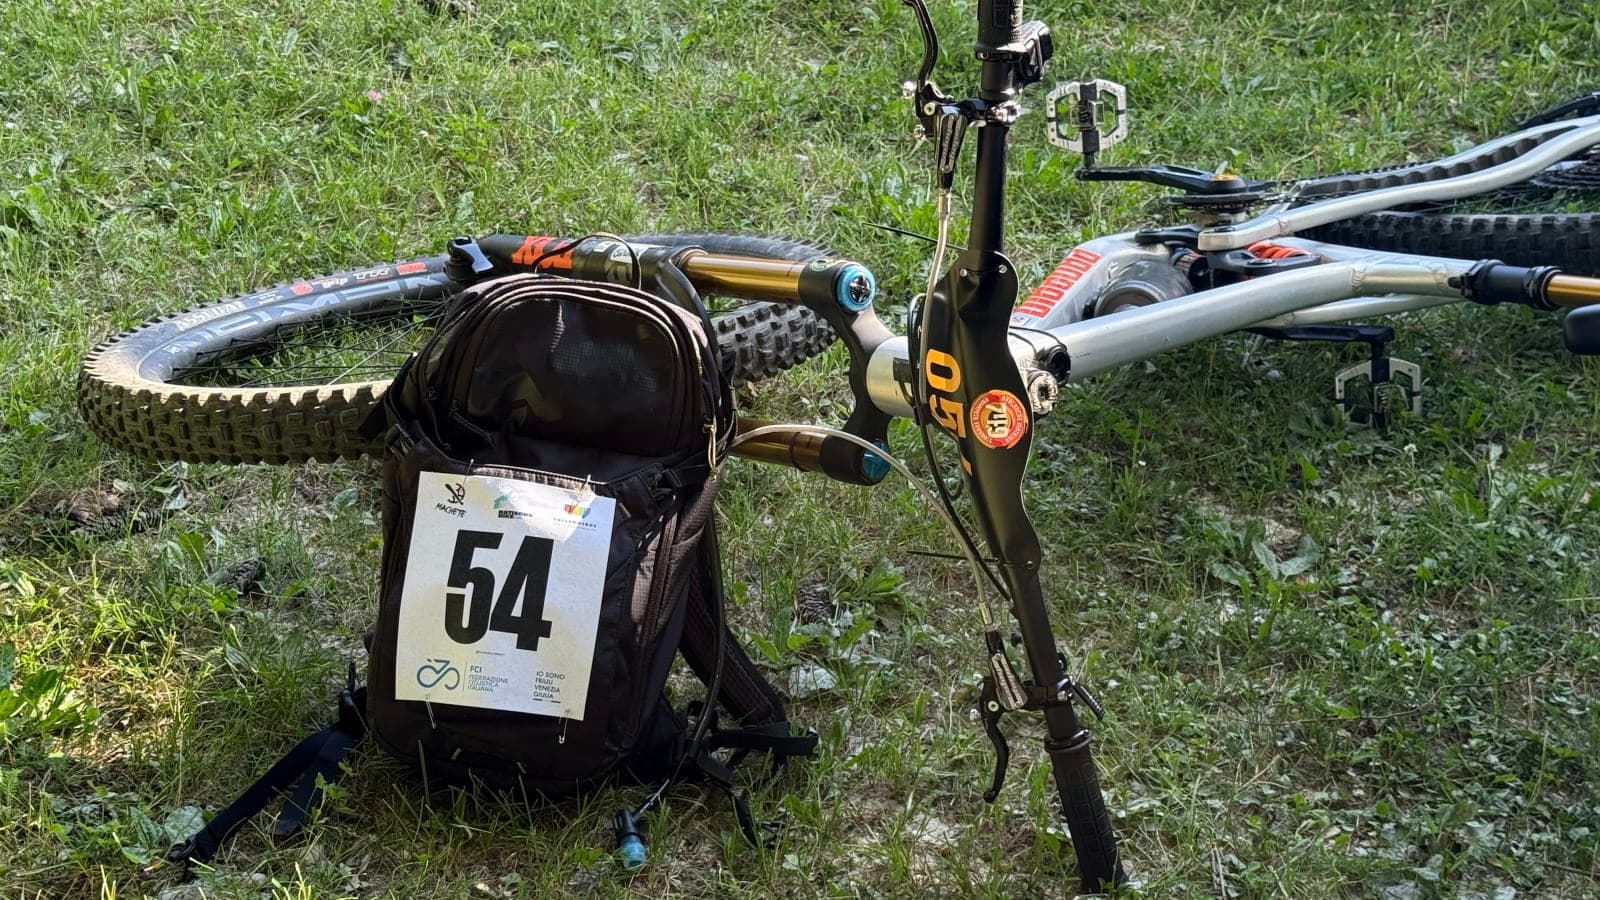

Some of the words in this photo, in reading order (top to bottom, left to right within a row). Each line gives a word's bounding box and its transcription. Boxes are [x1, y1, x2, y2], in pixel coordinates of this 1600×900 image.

[435, 502, 467, 518] MACHETE
[445, 529, 554, 651] 54
[469, 665, 482, 673] FCI
[545, 671, 565, 680] SONO
[534, 684, 561, 693] VENEZIA
[533, 691, 554, 699] GIULIA
